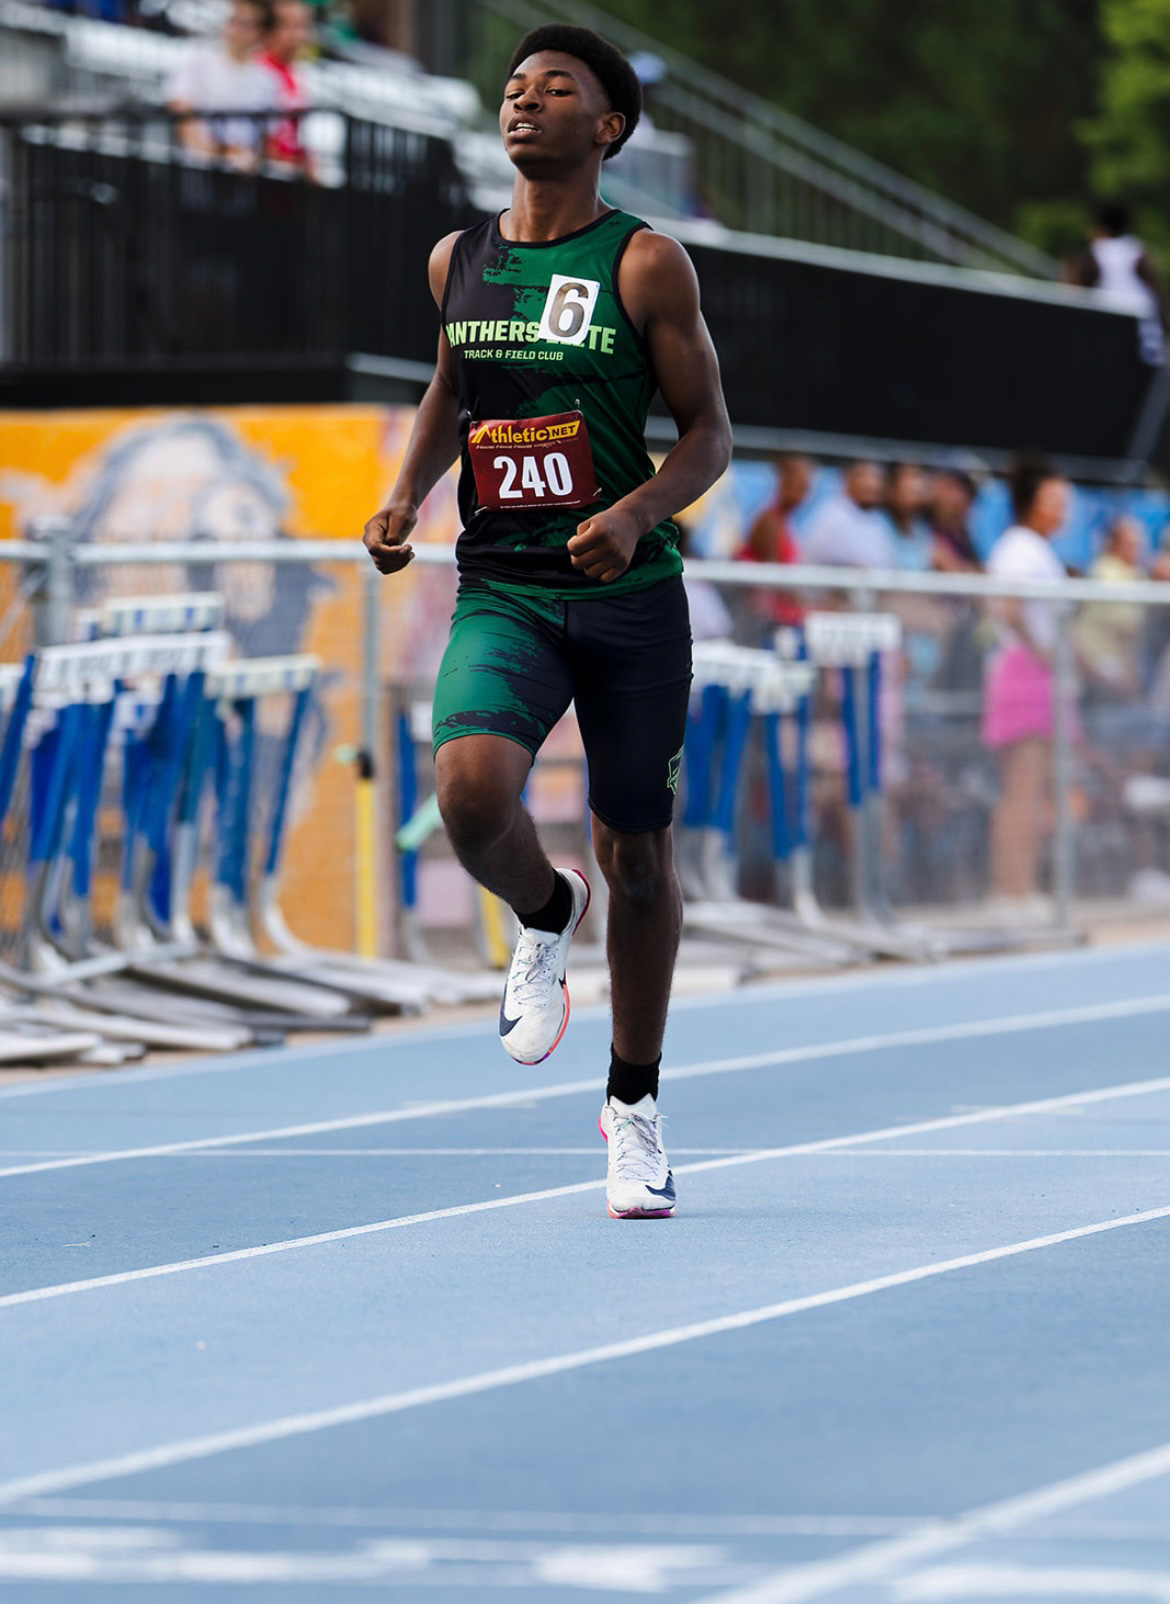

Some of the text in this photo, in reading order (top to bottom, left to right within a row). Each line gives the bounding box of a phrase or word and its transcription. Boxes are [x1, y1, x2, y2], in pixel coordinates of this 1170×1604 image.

[548, 282, 589, 338] 6
[446, 320, 541, 348] ANTHERS
[464, 350, 564, 361] TRACK & FIELD CLUB
[471, 424, 548, 444] Athletic
[493, 452, 574, 499] 240
